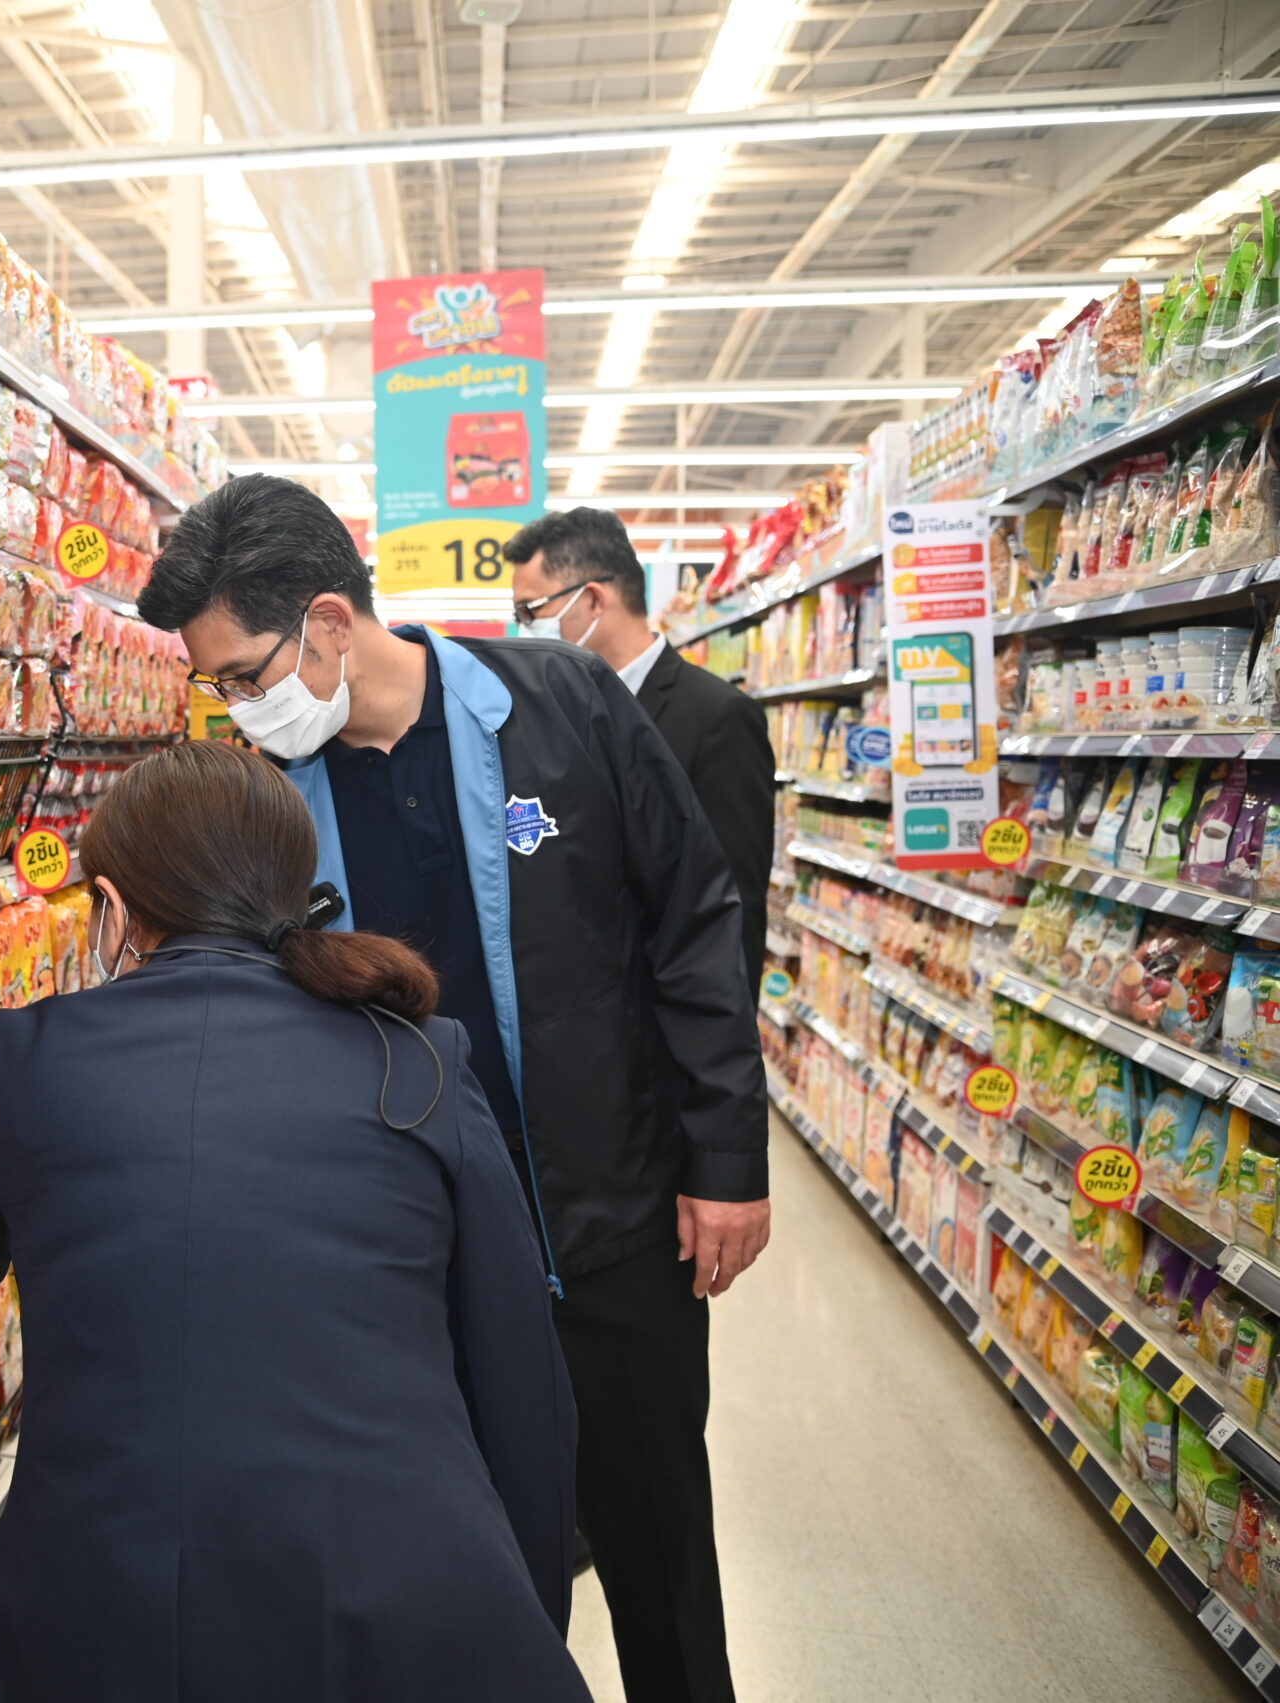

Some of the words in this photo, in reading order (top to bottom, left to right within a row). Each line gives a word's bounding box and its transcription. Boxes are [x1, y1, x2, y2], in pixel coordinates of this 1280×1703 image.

[64, 529, 99, 560] 2ชิ้น
[71, 547, 105, 575] ถูกกว่า
[443, 538, 503, 583] 18
[896, 645, 942, 671] my
[989, 824, 1023, 846] 2ชิ้น
[25, 834, 61, 866] 2ชิ้น
[28, 858, 64, 883] ถูกกว่า
[975, 1073, 1010, 1094] 2ชิ้น
[1088, 1154, 1132, 1180] 2ชิ้น
[1085, 1178, 1129, 1193] ถูกกว่า
[1223, 1623, 1233, 1637] 24
[1254, 1661, 1265, 1675] 43
